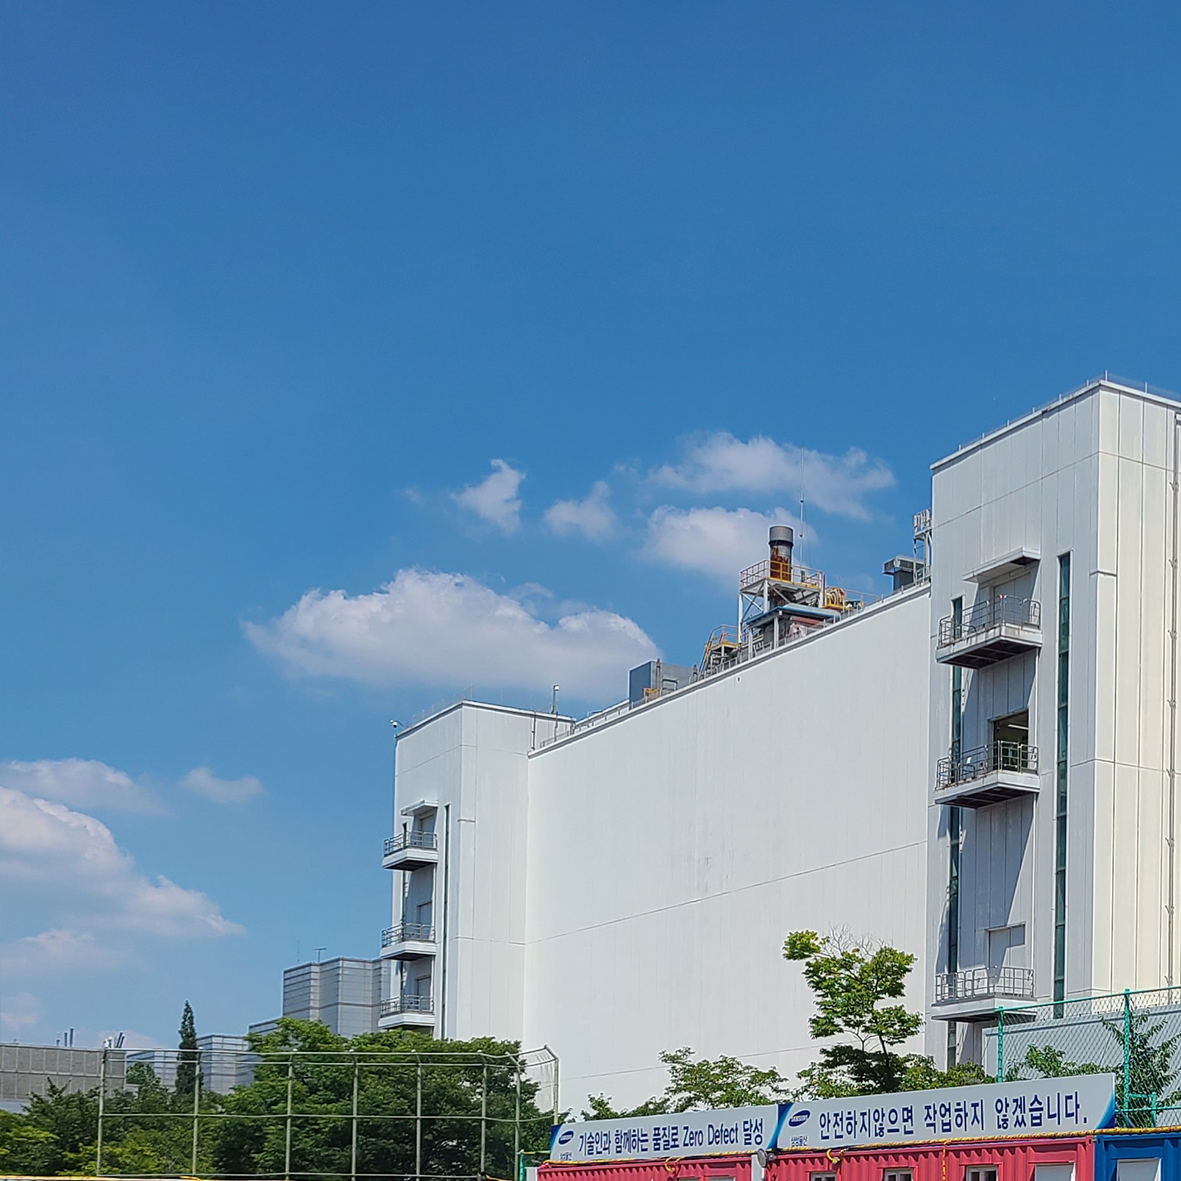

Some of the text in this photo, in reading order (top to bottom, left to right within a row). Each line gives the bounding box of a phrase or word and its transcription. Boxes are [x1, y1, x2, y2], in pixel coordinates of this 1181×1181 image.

[579, 1118, 764, 1156] 기술인과 함께하는 품질로 Zero Defect 달성
[819, 1091, 1088, 1140] 안전하지않으면 작업하지 않겠습니다.
